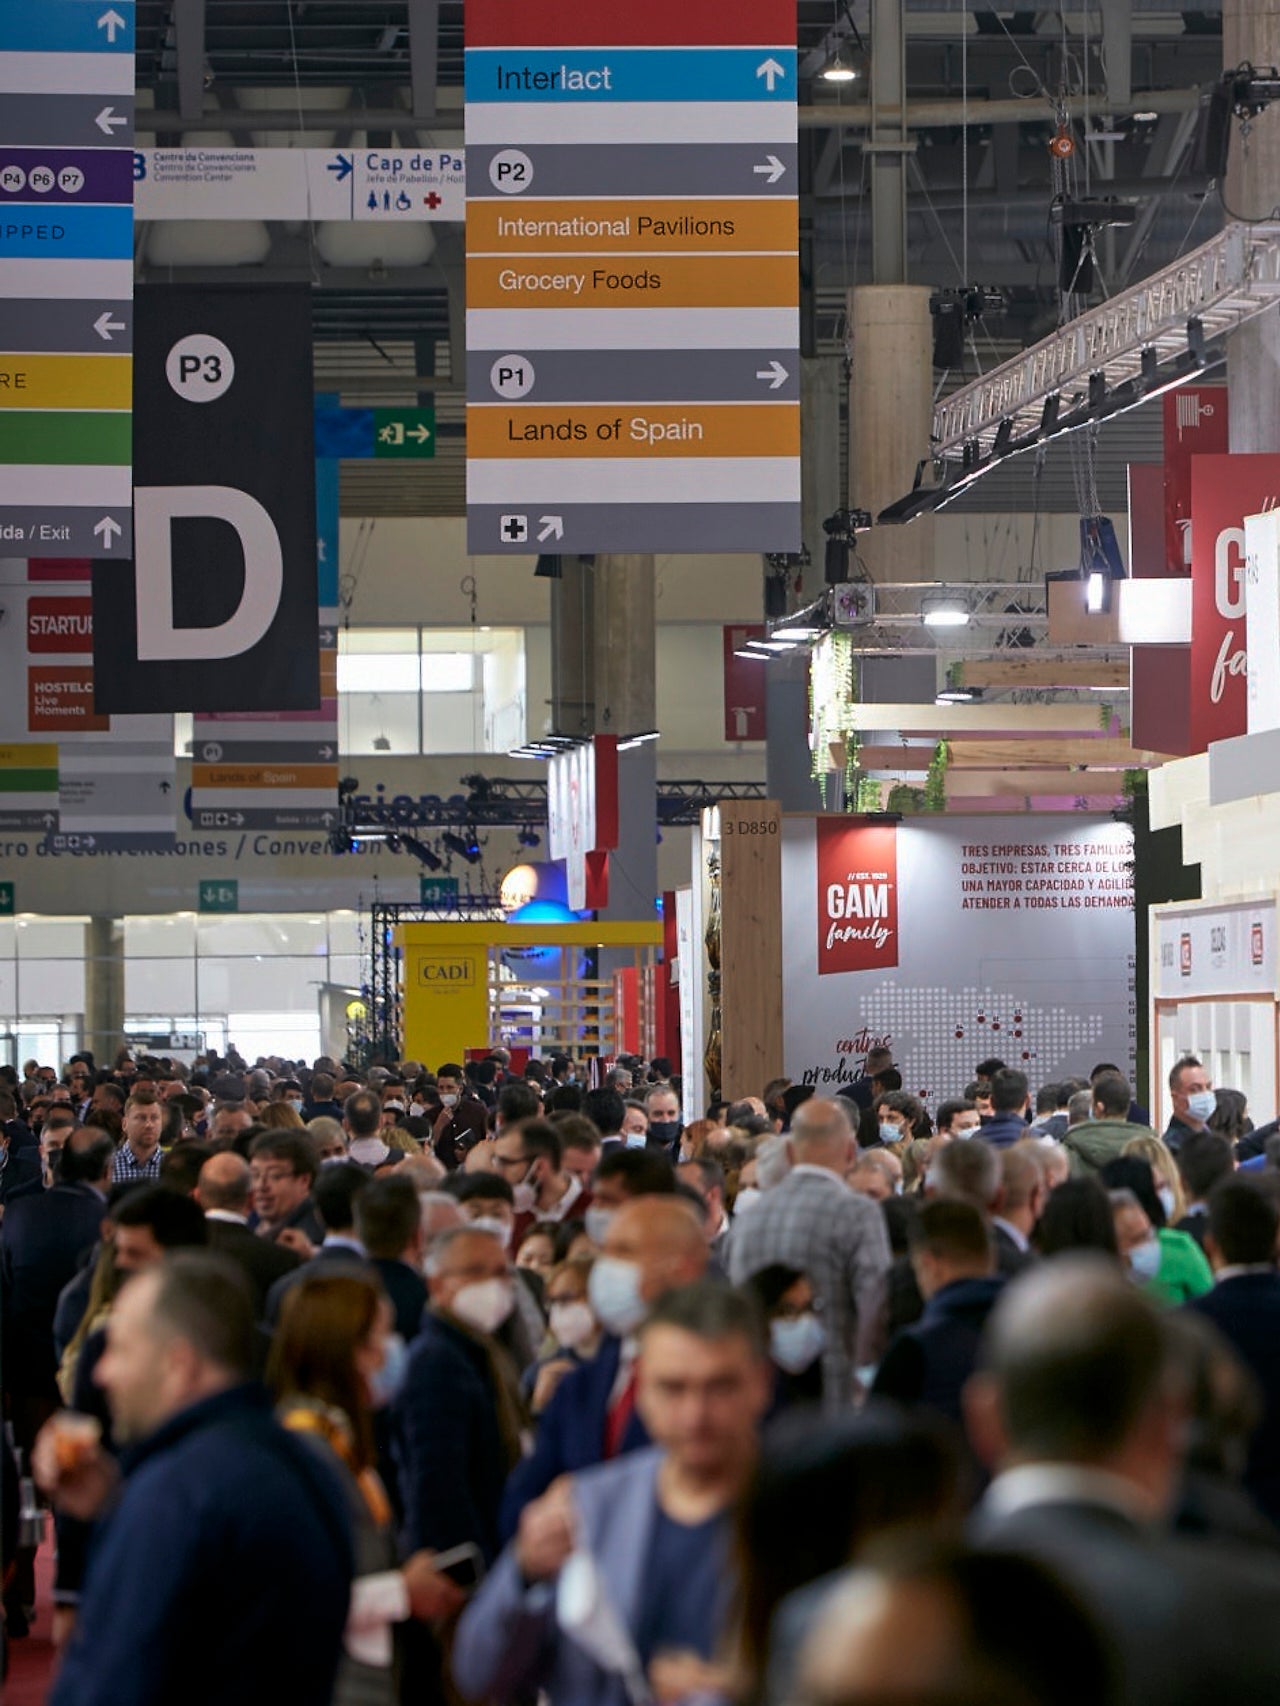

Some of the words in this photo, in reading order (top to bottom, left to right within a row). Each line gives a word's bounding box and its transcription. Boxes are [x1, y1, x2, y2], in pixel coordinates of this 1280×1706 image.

[498, 64, 612, 90] Interlact
[366, 153, 403, 175] Cap
[410, 154, 433, 171] de
[497, 163, 526, 182] P2
[3, 173, 20, 185] P4
[33, 174, 50, 185] P6
[62, 174, 79, 186] P7
[498, 216, 630, 236] International
[637, 215, 735, 236] Pavilions
[499, 270, 585, 294] Grocery
[592, 269, 661, 289] Foods
[180, 355, 222, 383] P3
[498, 367, 524, 386] P1
[508, 418, 587, 441] Lands
[596, 418, 622, 441] of
[630, 417, 703, 445] Spain
[39, 525, 70, 541] Exit
[133, 484, 284, 661] D
[34, 695, 58, 705] Live
[34, 706, 86, 716] Moments
[263, 772, 297, 785] Spain
[725, 821, 733, 834] 3
[738, 821, 777, 834] D850
[962, 845, 989, 857] TRES
[992, 845, 1050, 858] EMPRESAS,
[1054, 844, 1081, 856] TRES
[1084, 843, 1132, 856] FAMILIAS
[961, 863, 1018, 874] OBJETIVO:
[1021, 862, 1054, 874] ESTAR
[1057, 861, 1092, 873] CERCA
[1095, 861, 1108, 873] DE
[962, 880, 984, 892] UNA
[987, 880, 1022, 891] MAYOR
[1025, 879, 1085, 891] CAPACIDAD
[1088, 879, 1094, 890] Y
[827, 883, 888, 919] GAM
[962, 898, 1010, 909] ATENDER
[1013, 898, 1021, 909] A
[1023, 897, 1057, 908] TODAS
[1061, 897, 1081, 908] LAS
[826, 919, 894, 950] family
